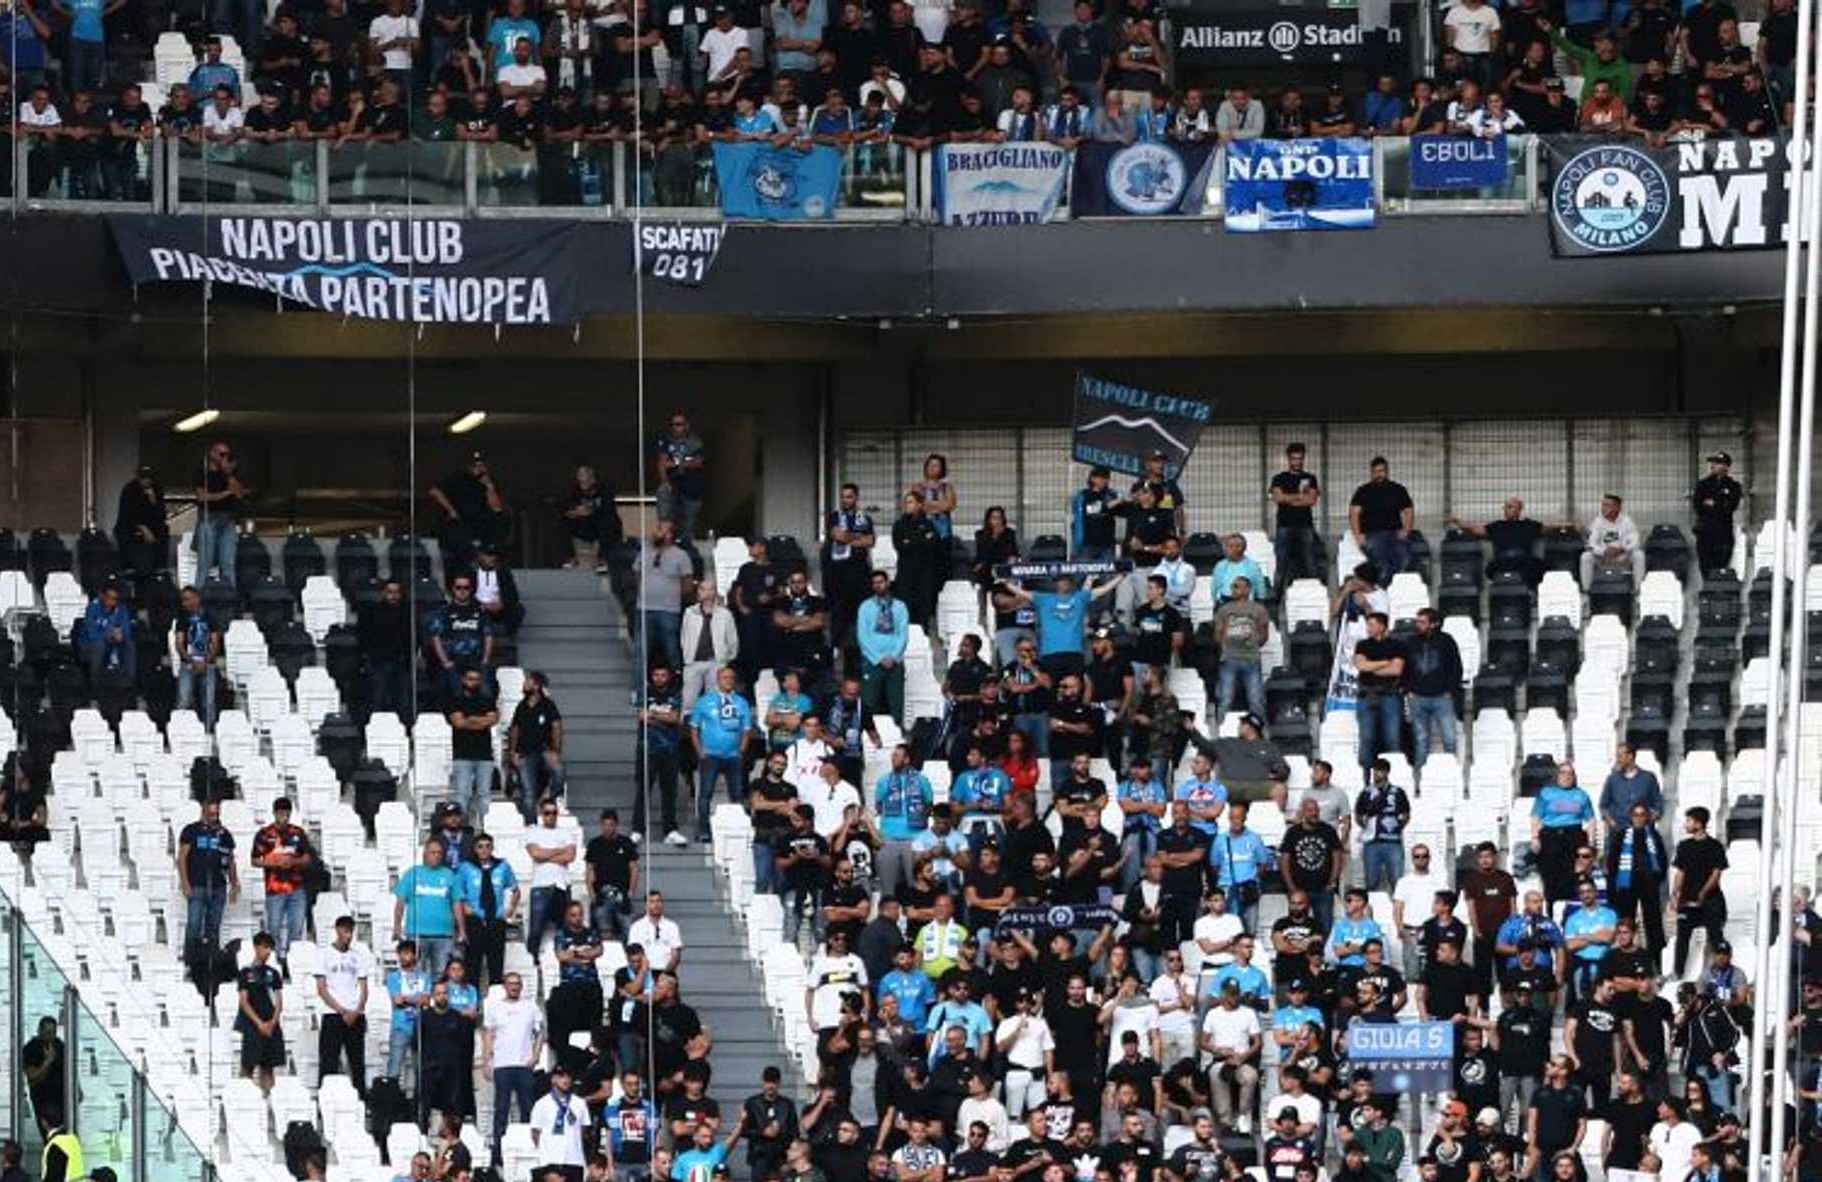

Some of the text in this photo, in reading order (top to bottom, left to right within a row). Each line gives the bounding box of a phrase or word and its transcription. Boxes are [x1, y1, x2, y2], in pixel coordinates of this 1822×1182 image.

[1180, 26, 1265, 48] Allianz
[946, 147, 1064, 172] BRACIGLIANO
[1421, 141, 1495, 163] EBOLI
[1228, 155, 1372, 181] NAPOLI
[1559, 150, 1663, 216] NAPOLI FAN CLUB
[220, 218, 465, 265] NAPOLI CLUB
[641, 225, 720, 252] SCAFATI
[1574, 220, 1649, 246] MILANO
[652, 252, 706, 281] 081
[149, 246, 551, 324] PIACENZA PARTENOPEA
[1081, 375, 1211, 421] NAPOLI CLUB
[1352, 1026, 1421, 1050] GIOIA
